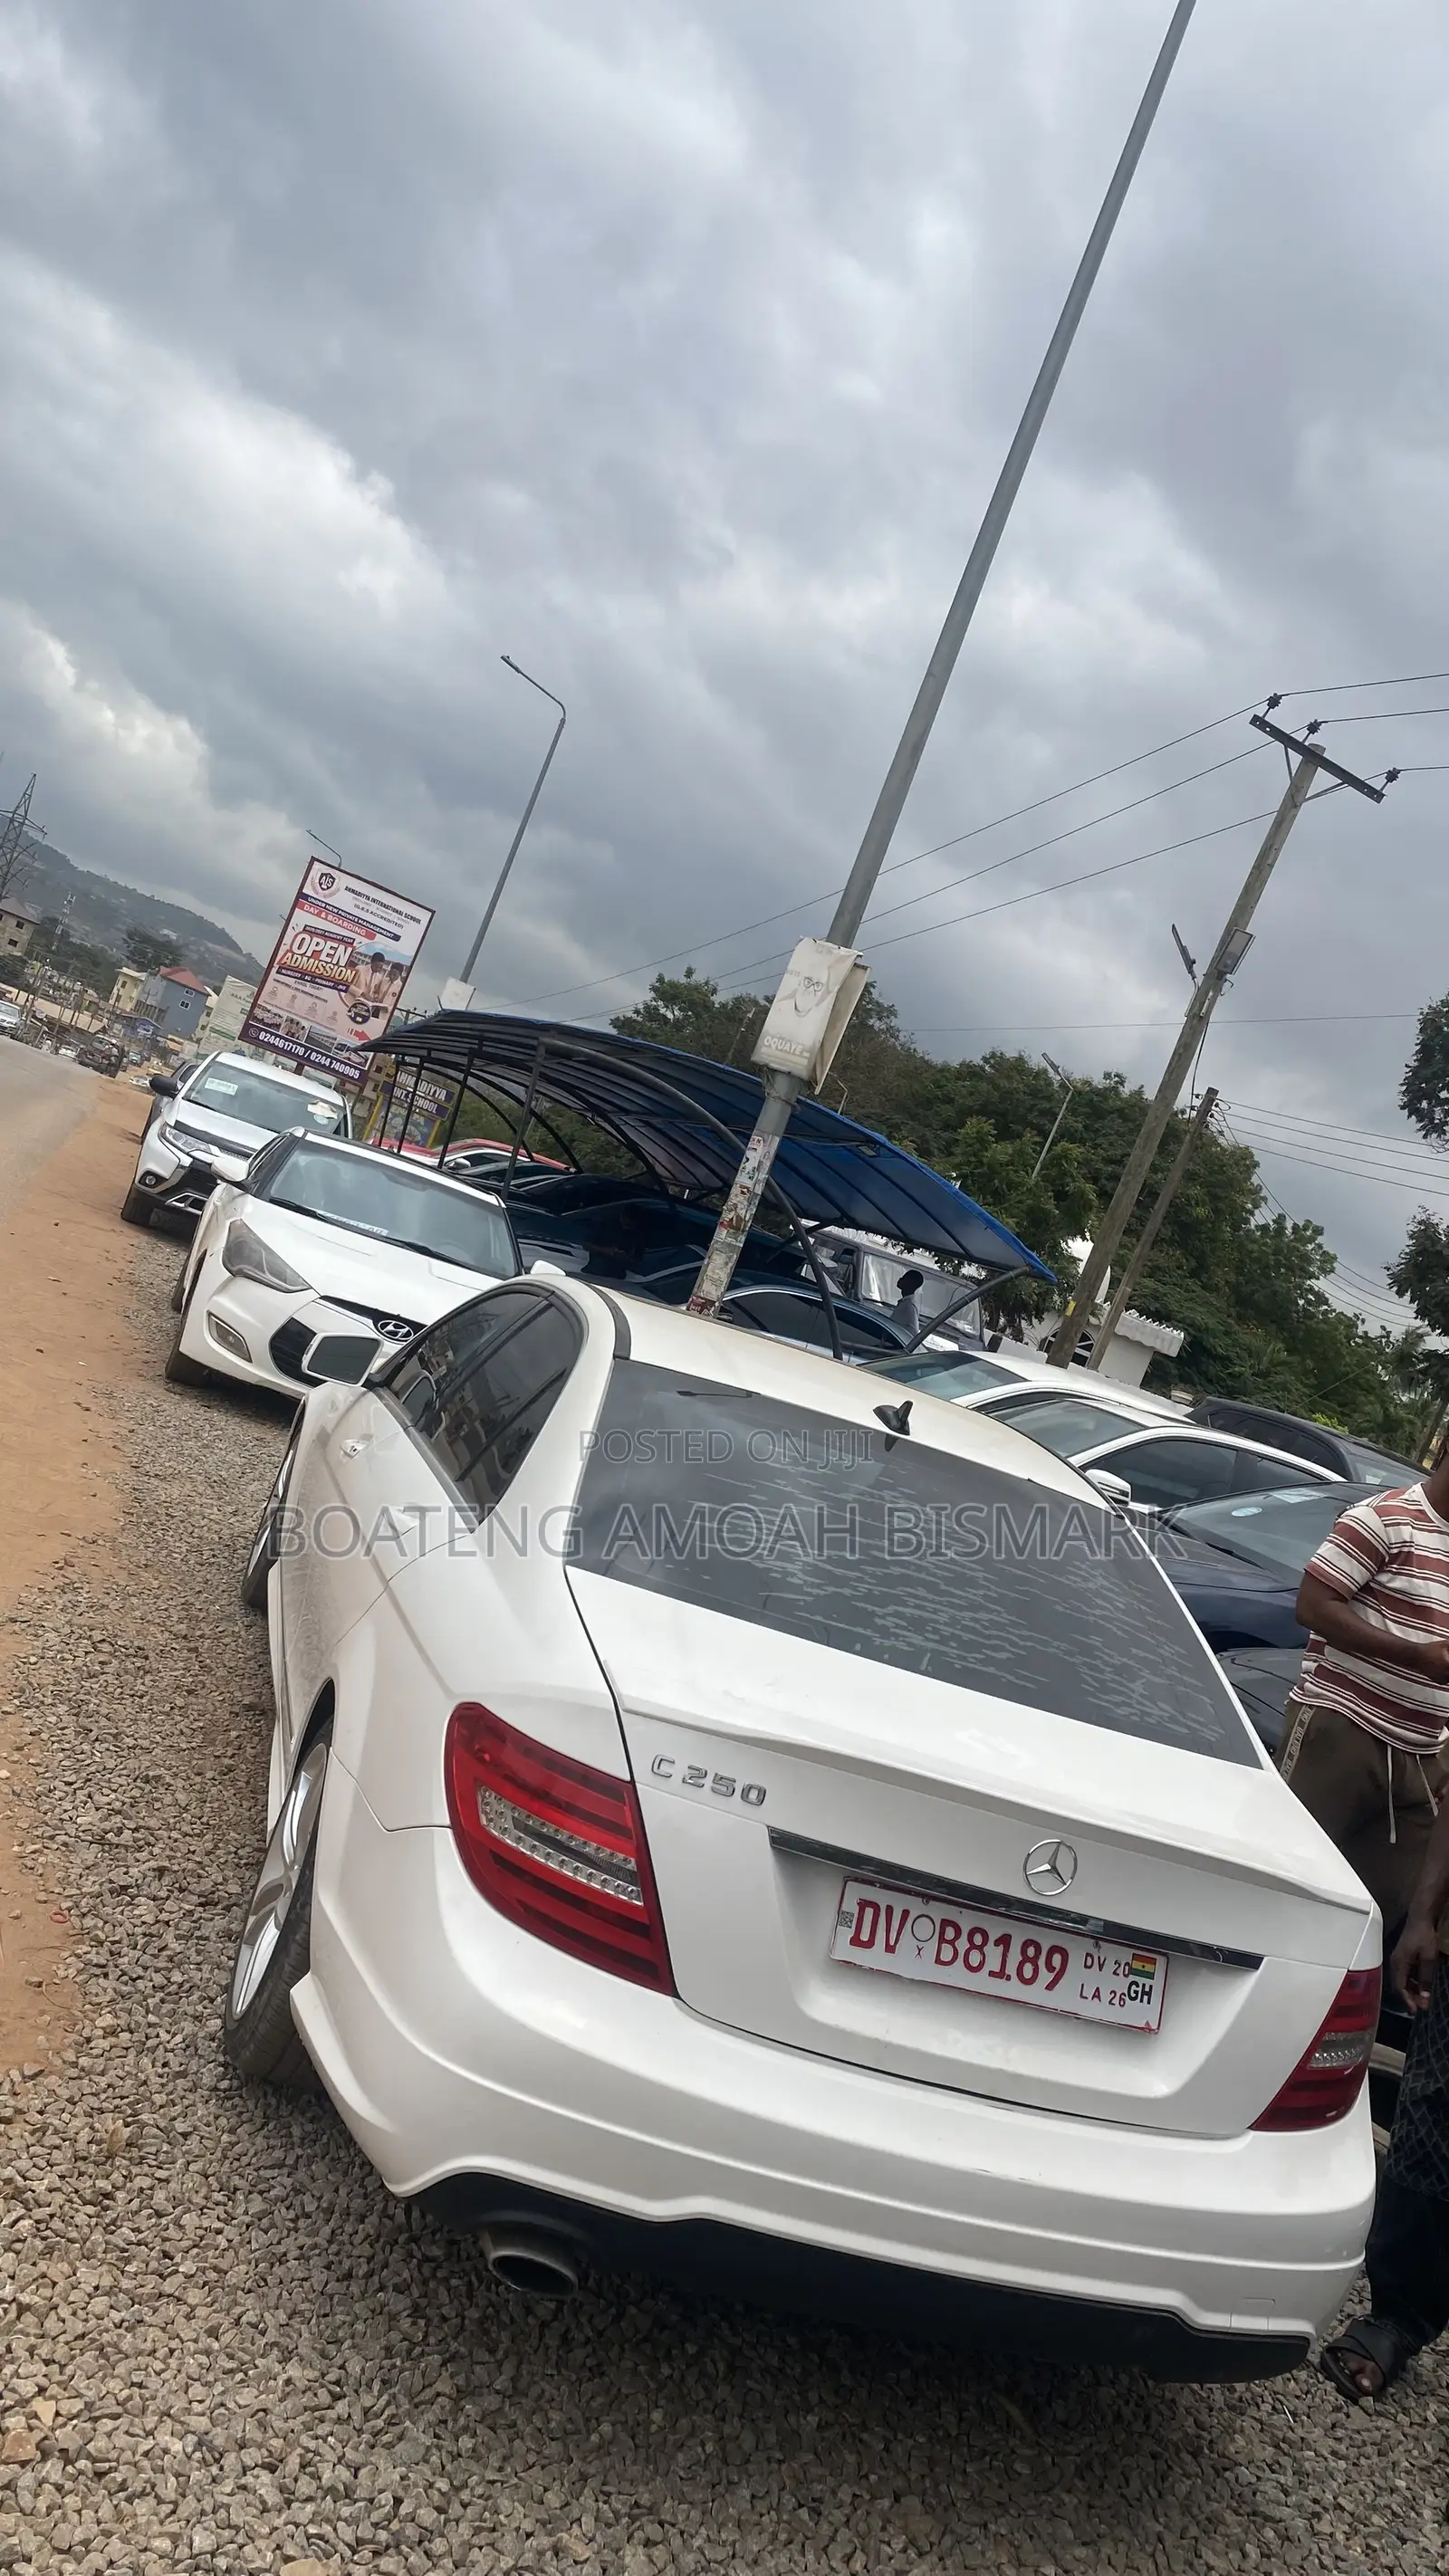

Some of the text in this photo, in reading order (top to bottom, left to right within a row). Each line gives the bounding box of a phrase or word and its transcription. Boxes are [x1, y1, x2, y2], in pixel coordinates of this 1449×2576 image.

[319, 874, 334, 887] AIS
[303, 904, 319, 915] DAY
[327, 915, 366, 935] BOARDING
[307, 896, 394, 938] UNDER NEW PRIVATE MANAGEMENT
[369, 897, 404, 916] INTERNATIONAL
[403, 912, 422, 924] SCHOOL
[293, 933, 353, 964] OPEN
[281, 954, 357, 982] ADMISSION
[258, 1030, 360, 1078] 0244617170 / 0244 740905
[763, 1036, 803, 1055] OQUAYE
[651, 1754, 767, 1806] C 250
[849, 1899, 910, 1955] DV
[934, 1919, 1070, 1992] B8189
[1083, 1952, 1130, 1978] DV 20
[1080, 1983, 1127, 2008] LA 26
[1128, 1980, 1153, 2006] GH
